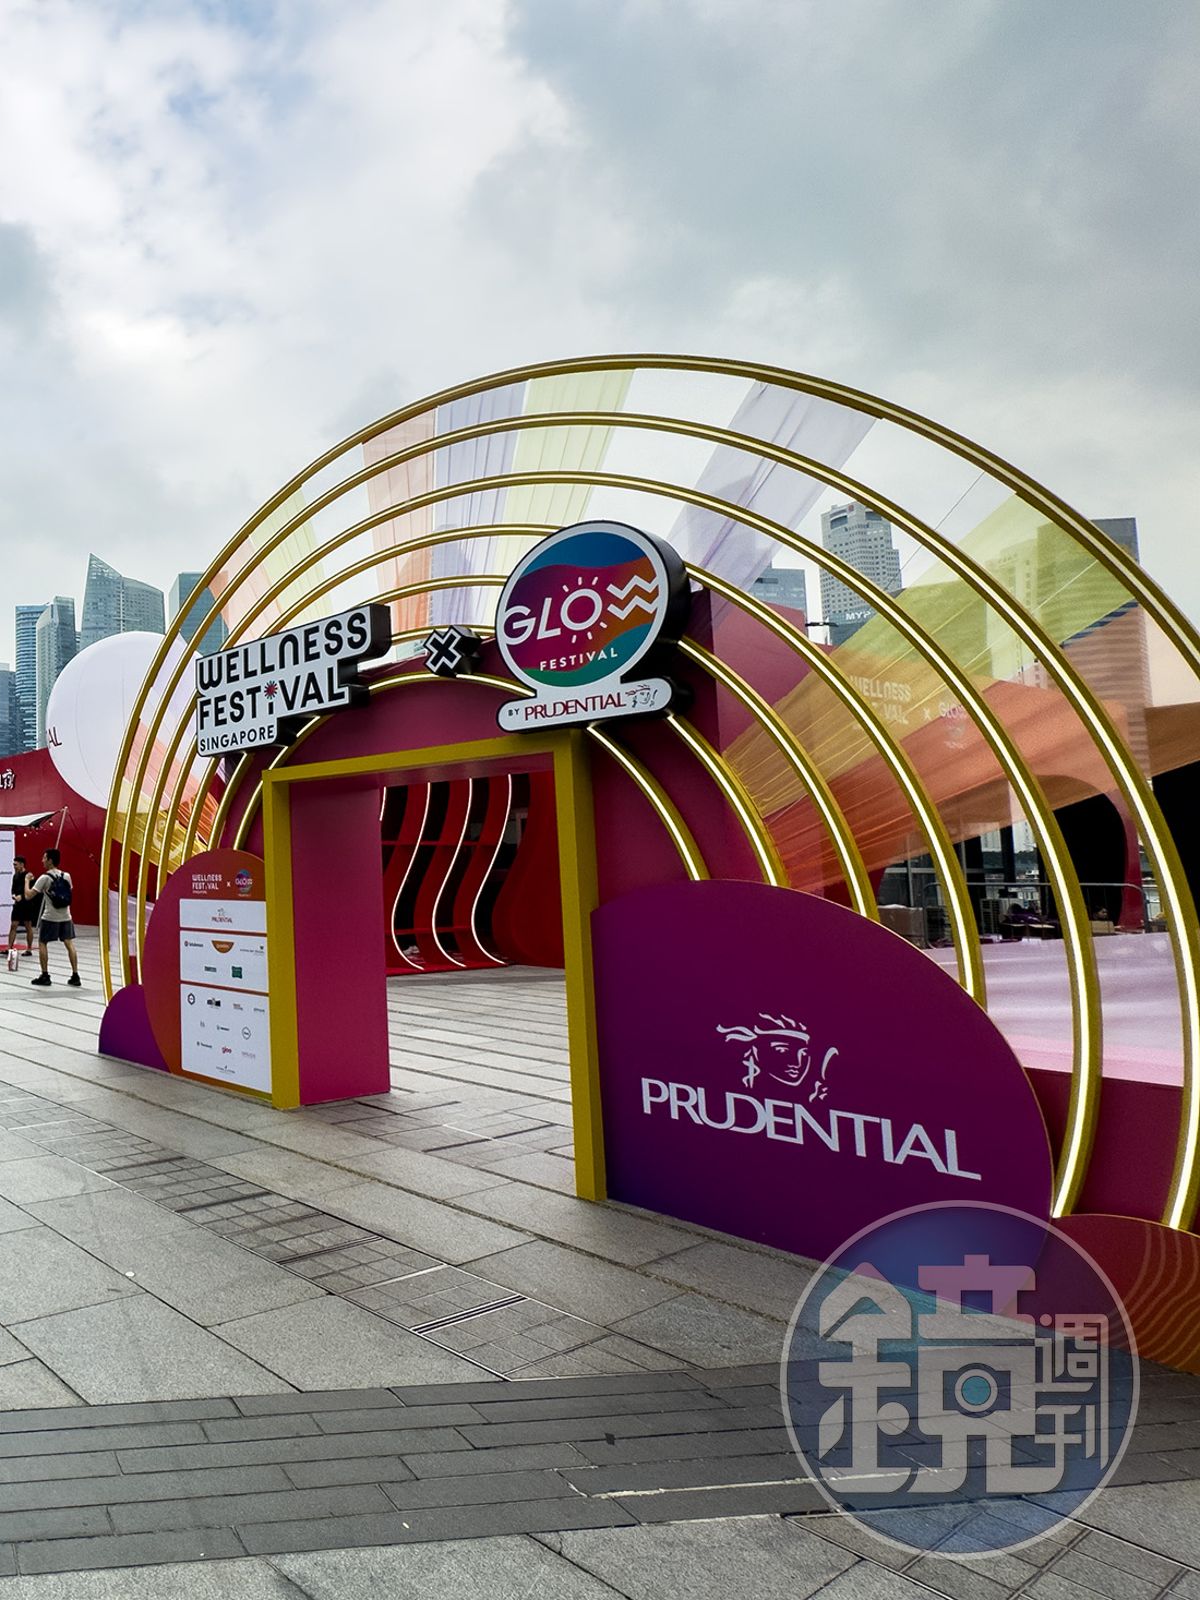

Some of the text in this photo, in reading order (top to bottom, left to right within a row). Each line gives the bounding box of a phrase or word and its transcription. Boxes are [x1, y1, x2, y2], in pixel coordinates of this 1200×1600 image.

[199, 612, 367, 691] WELLNESS
[540, 647, 618, 671] FESTIVAL
[508, 692, 626, 721] BY PRUDENTIAL
[200, 725, 275, 752] SINGAPORE
[641, 1077, 982, 1181] PRUDENTIAL
